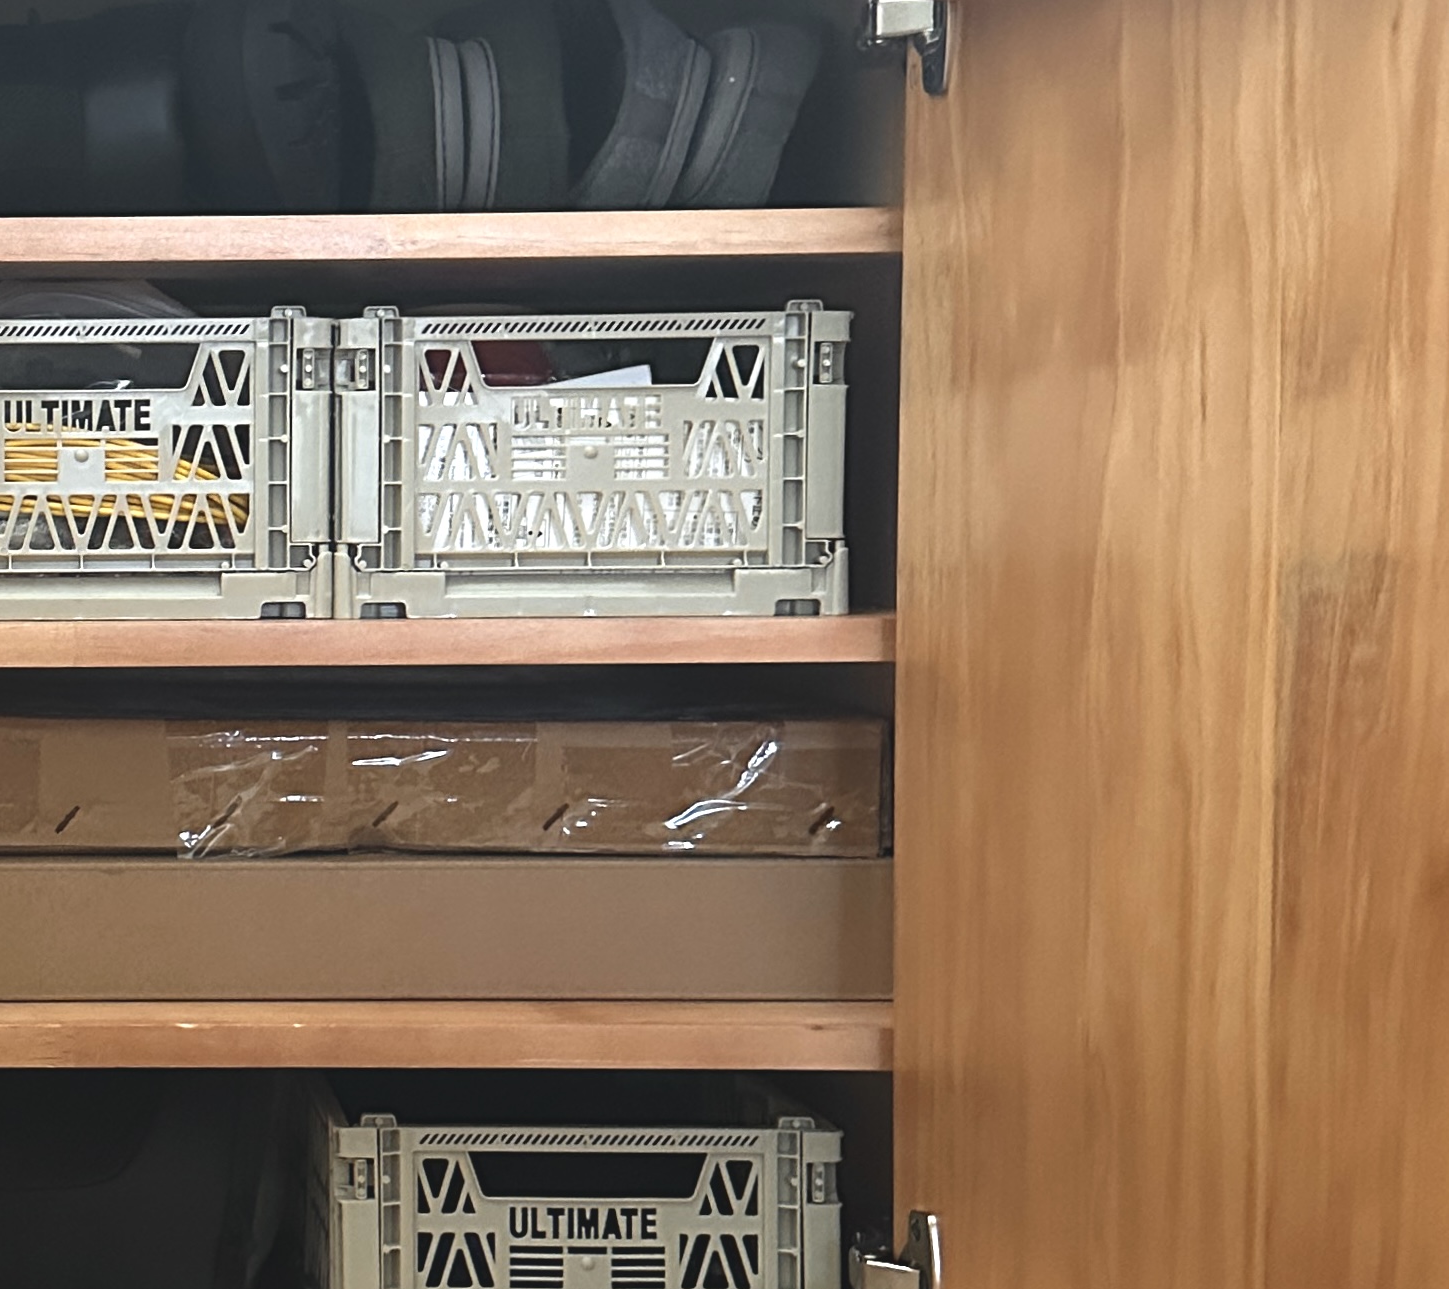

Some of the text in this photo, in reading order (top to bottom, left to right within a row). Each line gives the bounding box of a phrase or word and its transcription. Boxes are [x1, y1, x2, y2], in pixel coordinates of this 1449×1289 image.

[4, 399, 151, 432] ULTIMATE
[511, 394, 662, 431] ULTIMATE
[509, 1206, 657, 1239] ULTIMATE
